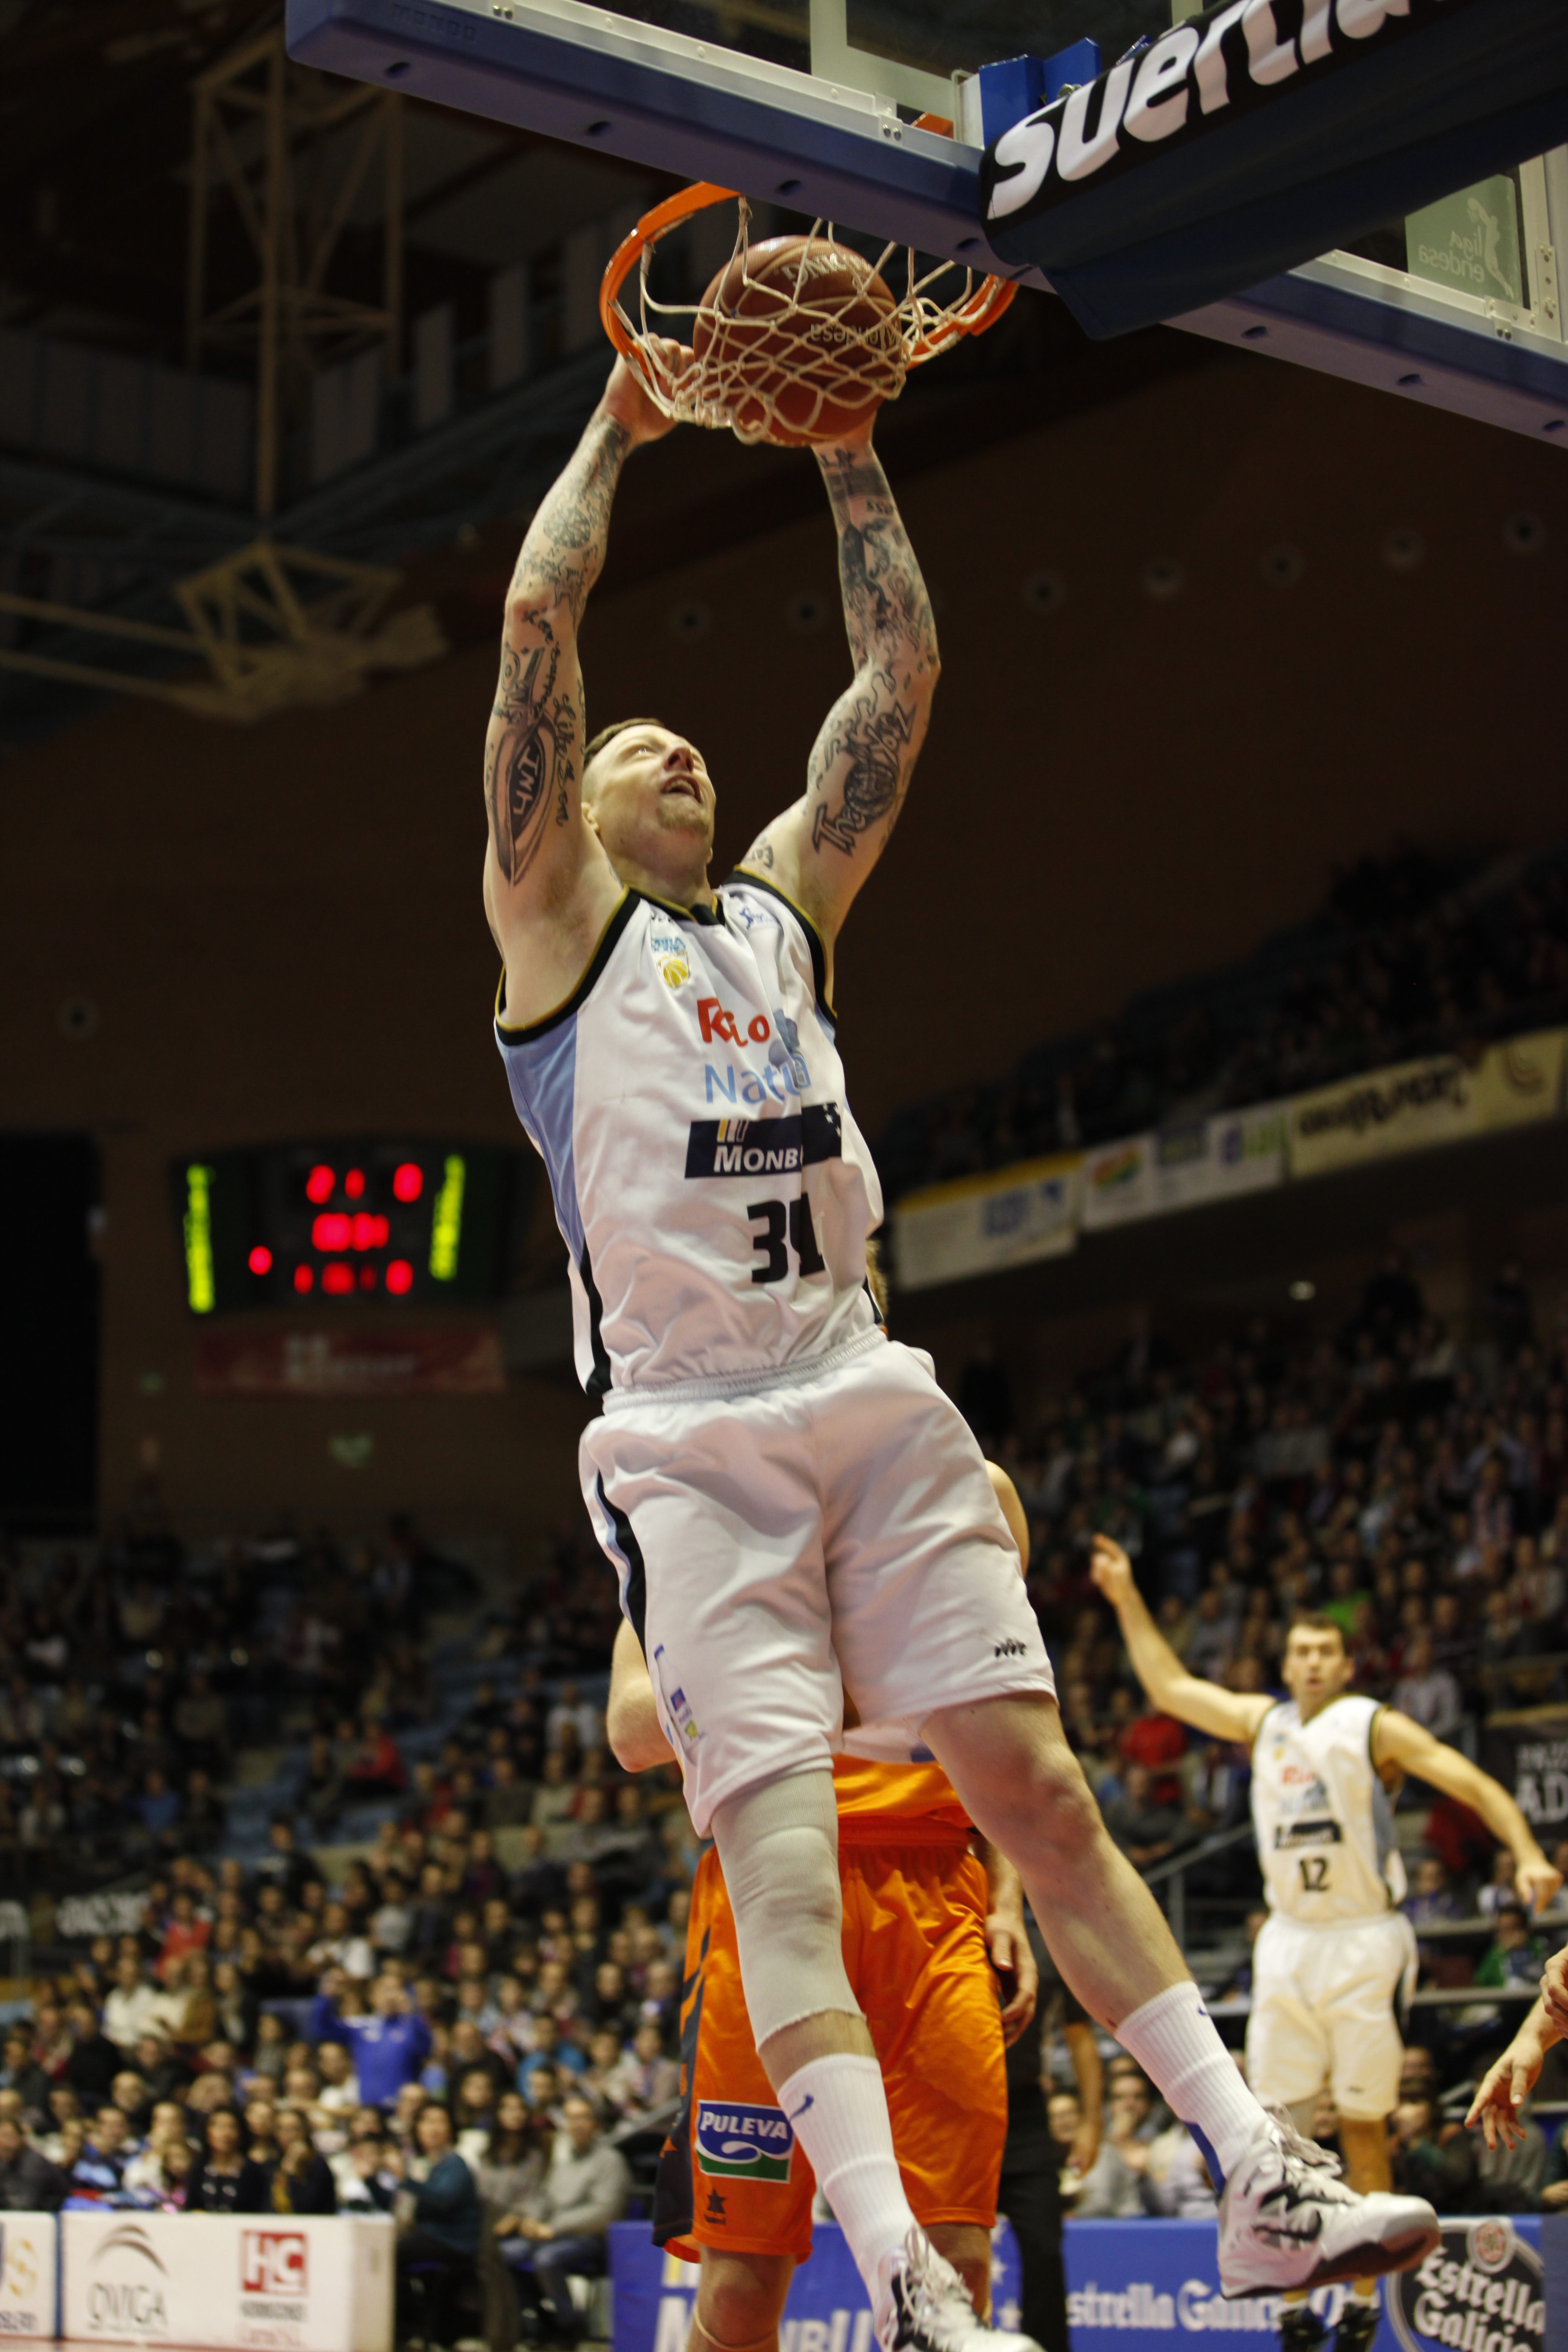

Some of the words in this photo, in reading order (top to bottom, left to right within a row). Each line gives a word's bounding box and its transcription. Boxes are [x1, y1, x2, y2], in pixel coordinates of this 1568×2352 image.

[714, 1144, 803, 1173] MONB
[1300, 1857, 1331, 1892] 12
[699, 2111, 789, 2140] PULEVA
[1414, 2245, 1546, 2336] Estrella
